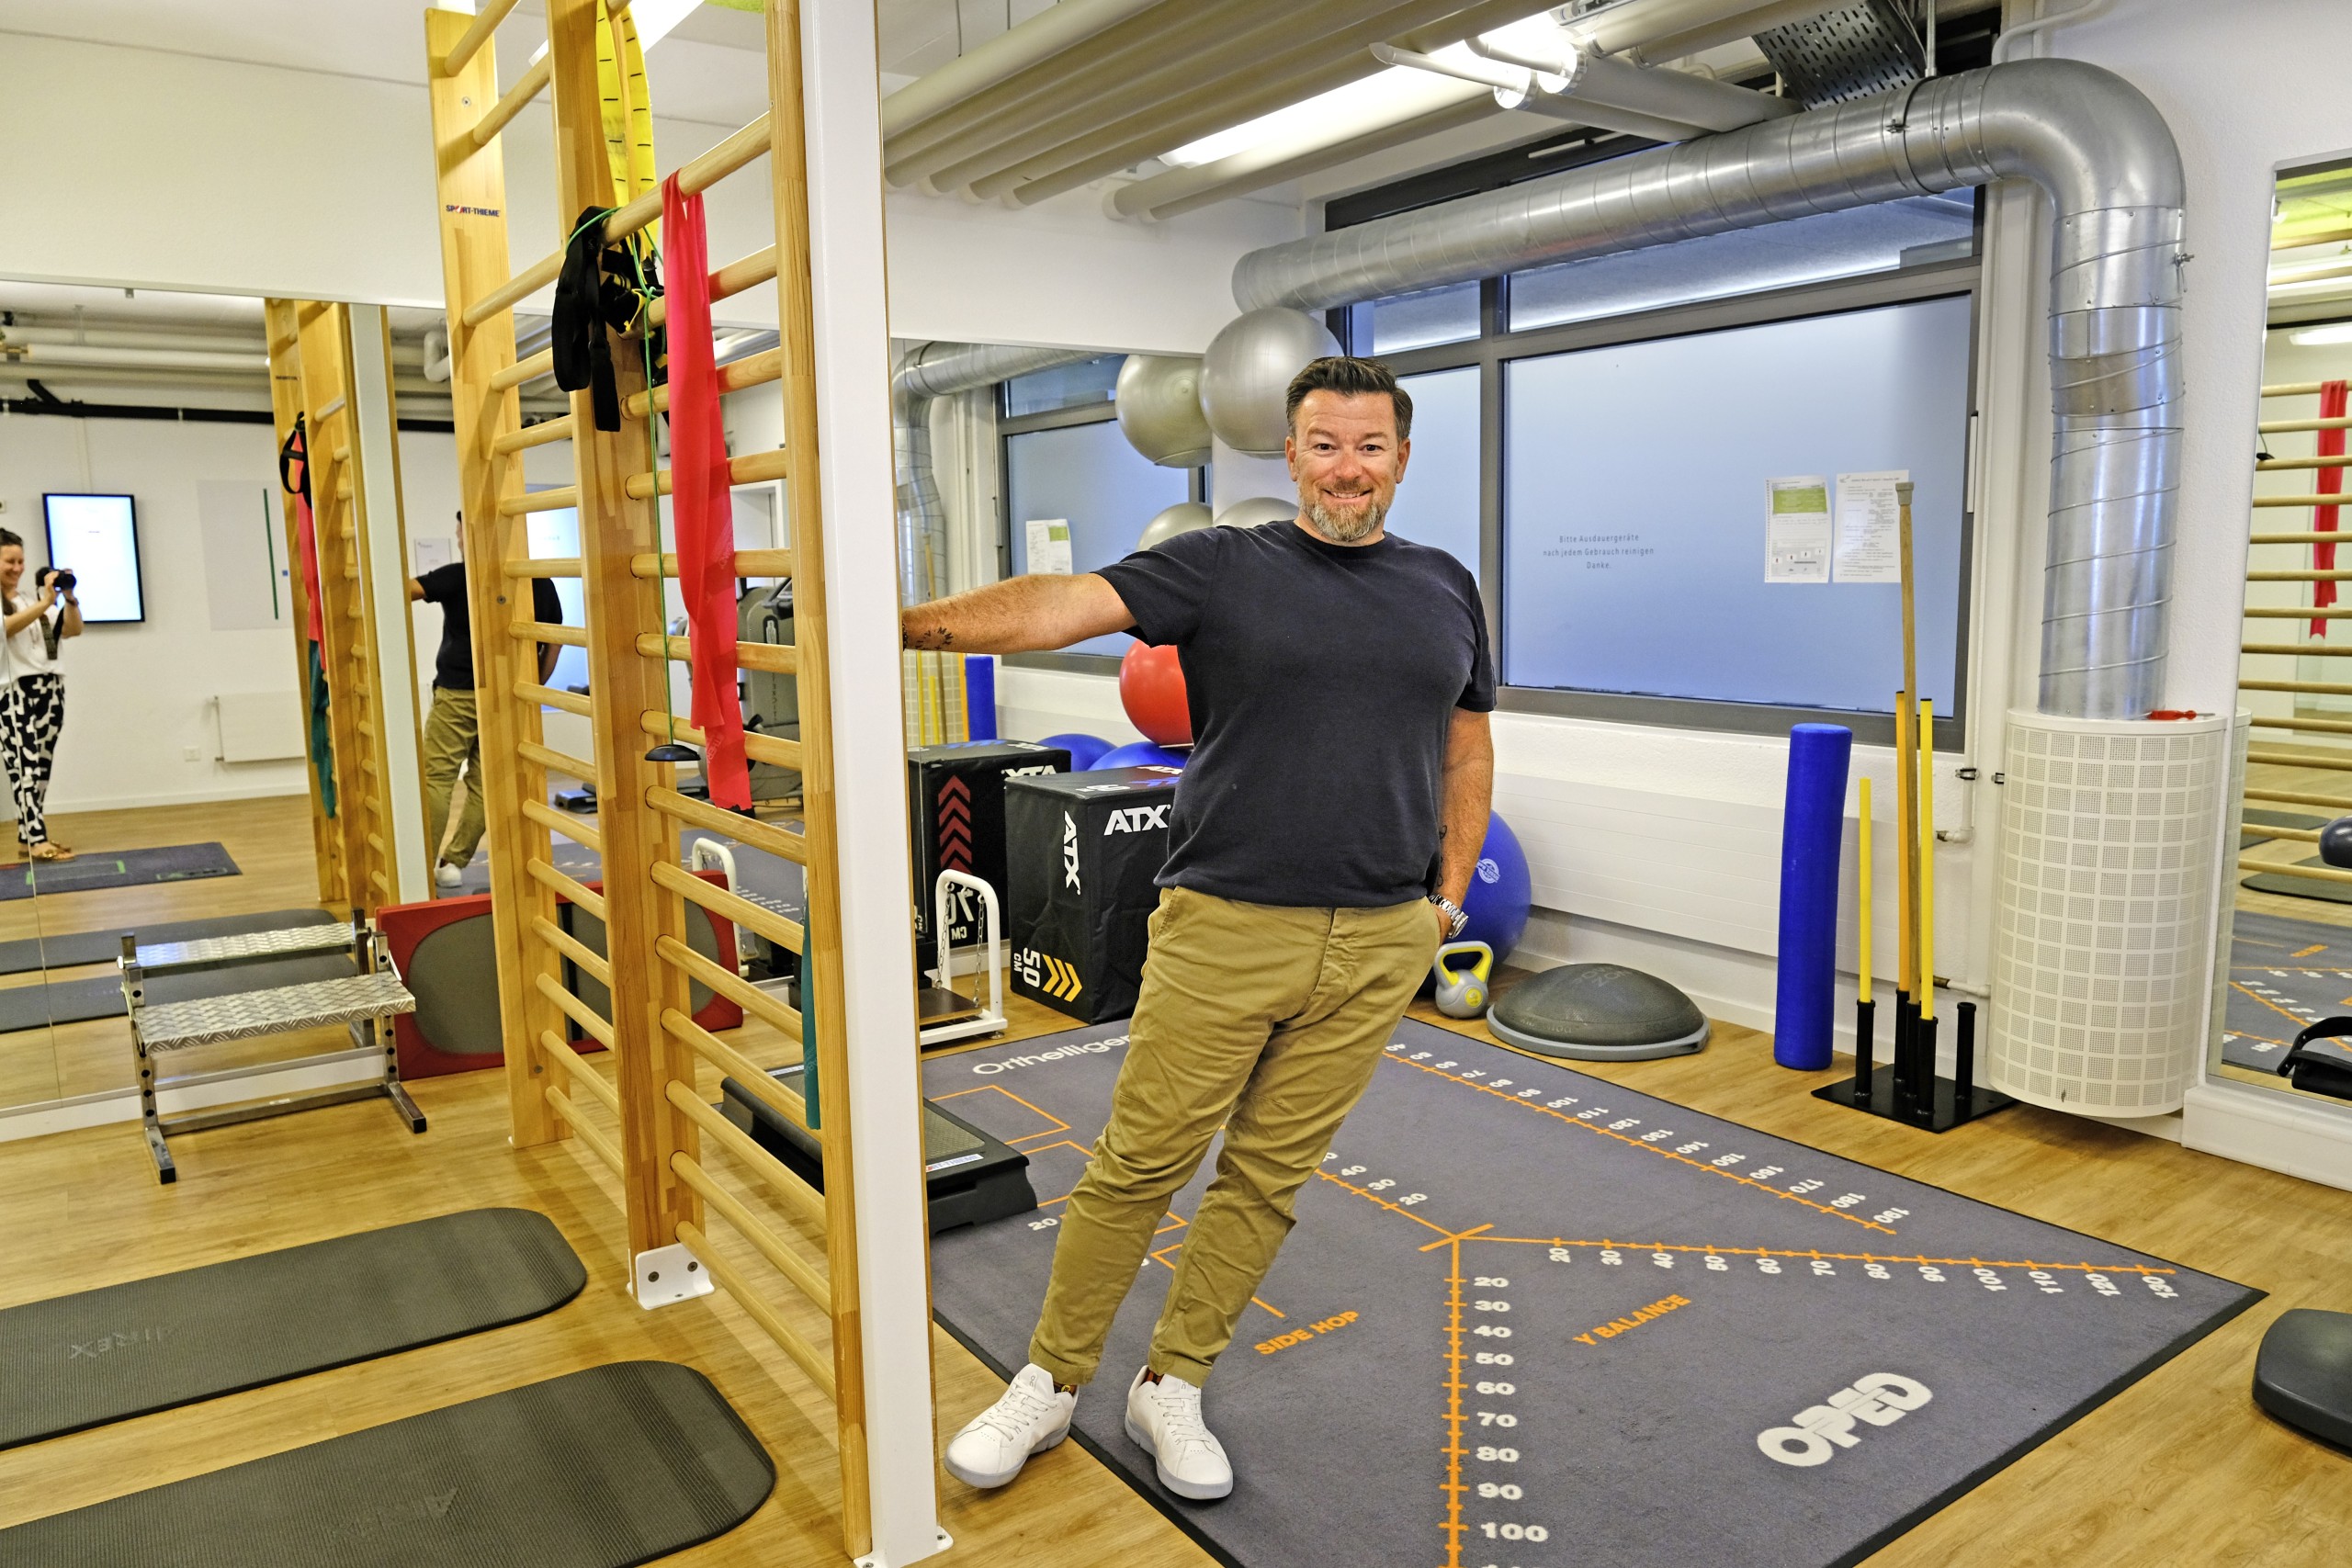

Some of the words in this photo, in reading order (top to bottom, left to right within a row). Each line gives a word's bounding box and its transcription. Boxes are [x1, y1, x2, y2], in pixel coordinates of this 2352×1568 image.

[1578, 534, 1639, 543] Ausdauergeräte
[1561, 548, 1583, 558] jedem
[1584, 547, 1620, 556] Gebrauch
[1621, 547, 1655, 557] reinigen
[1103, 804, 1171, 836] ATX
[1063, 810, 1081, 895] ATX
[1013, 953, 1023, 974] CM
[1023, 947, 1041, 988] 50
[1546, 1097, 1578, 1109] 100
[1577, 1107, 1609, 1119] 110
[1608, 1118, 1641, 1130] 120
[1641, 1129, 1674, 1142] 130
[1676, 1141, 1710, 1154] 140
[1323, 1152, 1339, 1162] 0
[1711, 1153, 1746, 1167] 150
[1341, 1165, 1367, 1177] 40
[1749, 1165, 1784, 1179] 160
[1368, 1179, 1396, 1190] 30
[1789, 1179, 1825, 1194] 170
[1398, 1193, 1428, 1205] 20
[1830, 1192, 1867, 1209] 180
[1872, 1207, 1911, 1224] 190
[1028, 1217, 1059, 1231] 20
[1549, 1247, 1571, 1264] 20
[1600, 1249, 1623, 1266] 30
[1652, 1252, 1675, 1269] 40
[1703, 1255, 1729, 1271] 50
[1755, 1258, 1782, 1274] 60
[1810, 1260, 1837, 1276] 70
[1863, 1263, 1891, 1280] 80
[1918, 1266, 1947, 1282] 90
[1474, 1277, 1510, 1288] 20
[1973, 1268, 2007, 1292] 100
[2028, 1270, 2064, 1293] 110
[2085, 1273, 2121, 1297] 120
[2141, 1275, 2179, 1299] 130
[1474, 1301, 1510, 1312] 30
[1572, 1332, 1597, 1346] Y
[1592, 1293, 1692, 1338] BALANCE
[1254, 1328, 1315, 1355] SIDE
[1308, 1310, 1359, 1334] HOP
[1474, 1325, 1512, 1337] 40
[1476, 1352, 1514, 1365] 50
[1476, 1382, 1516, 1395] 60
[1477, 1411, 1518, 1427] 70
[1757, 1372, 1933, 1467] OPED
[1476, 1446, 1520, 1462] 80
[1477, 1483, 1523, 1500] 90
[1481, 1521, 1549, 1542] 100
